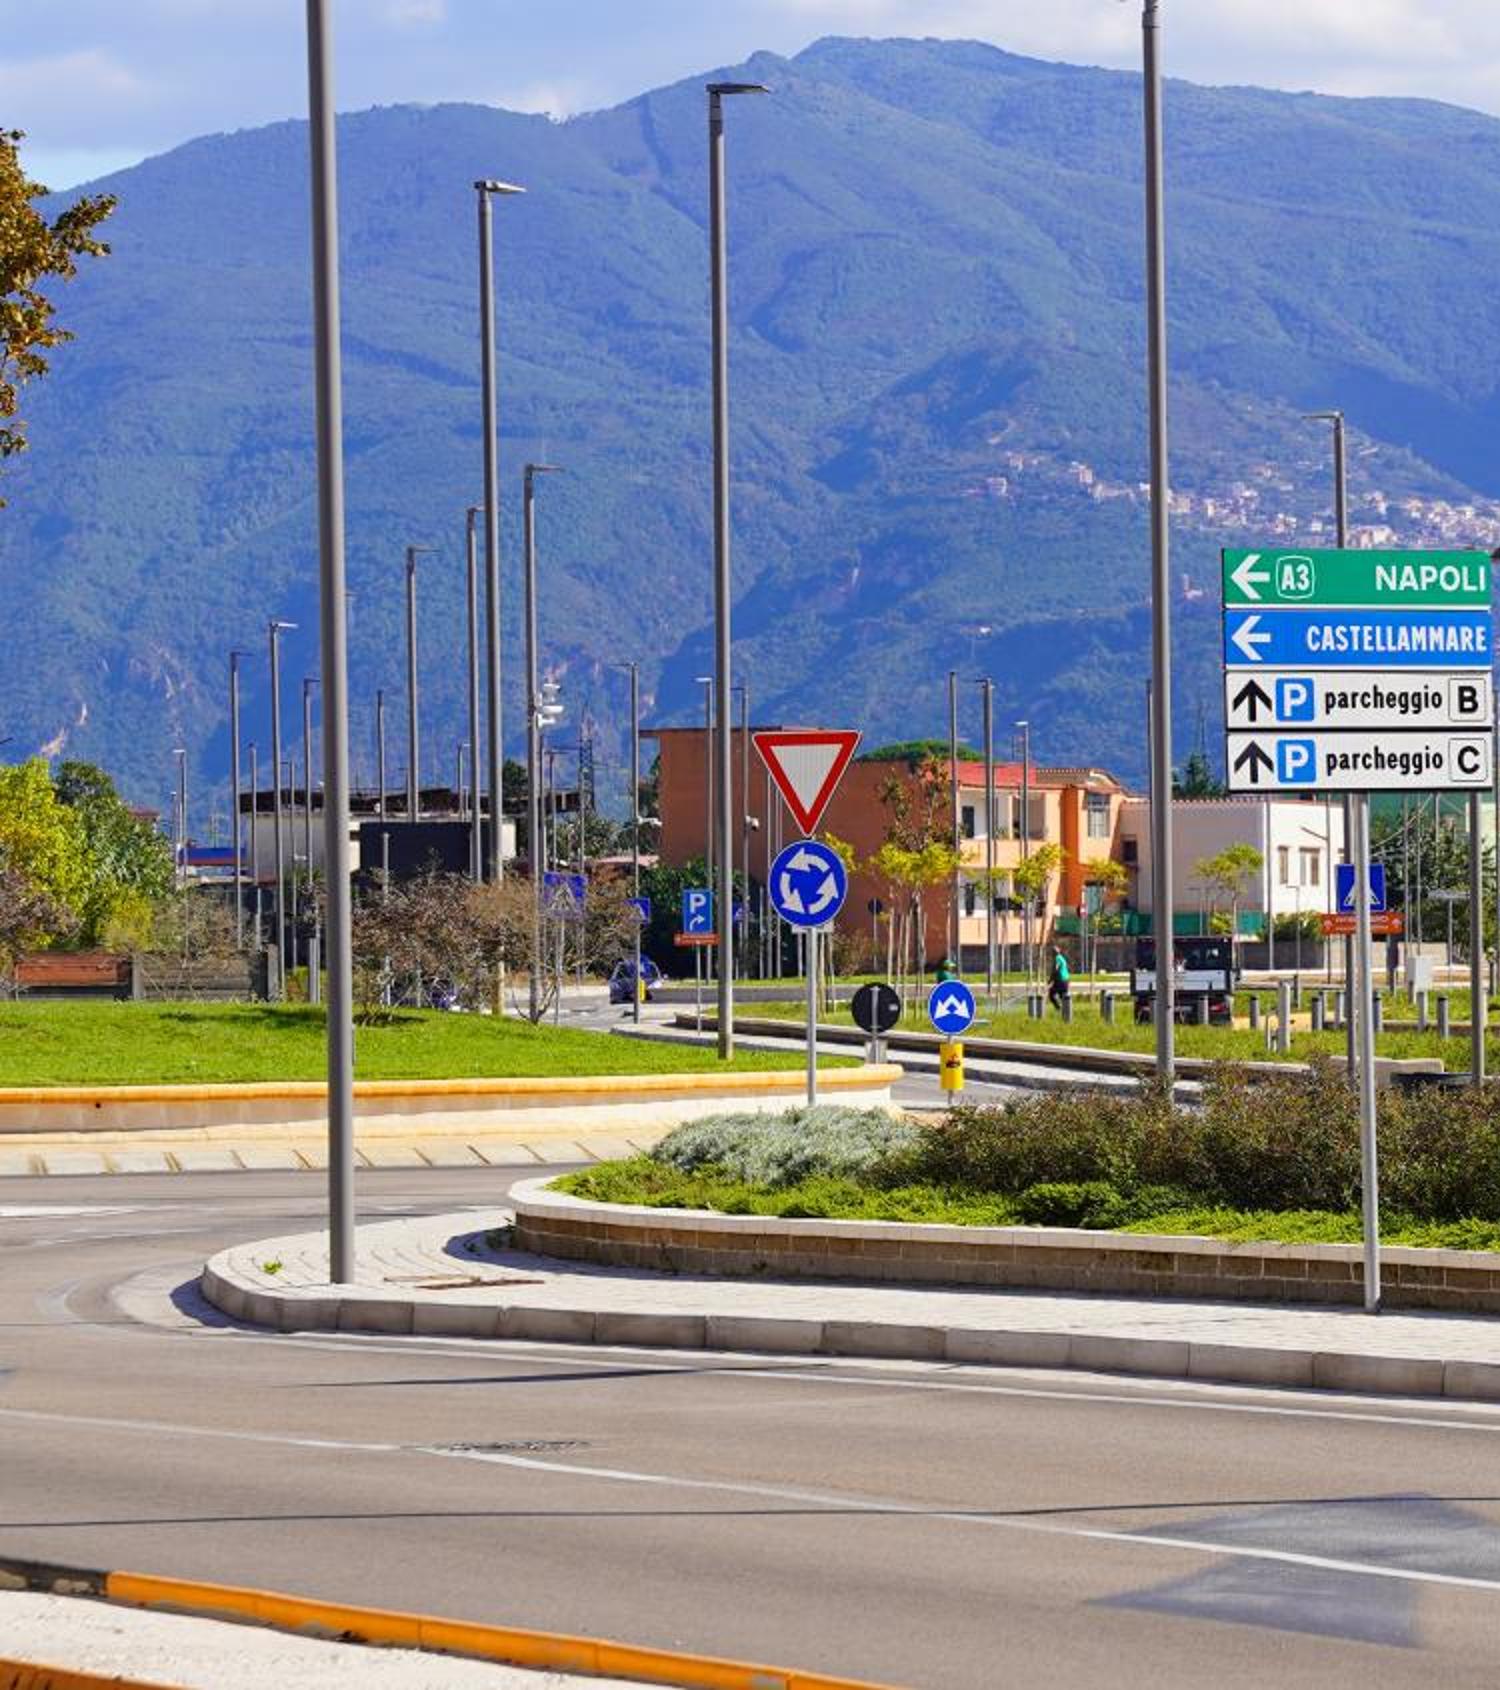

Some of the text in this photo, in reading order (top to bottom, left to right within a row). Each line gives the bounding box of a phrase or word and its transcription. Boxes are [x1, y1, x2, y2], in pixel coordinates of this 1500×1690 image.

[1281, 564, 1486, 591] A3 NAPOLI
[1306, 625, 1487, 651] CASTELLAMMARE
[1283, 684, 1479, 717] P parcheggio B
[1285, 745, 1480, 778] P parcheggio C
[690, 894, 706, 913] P
